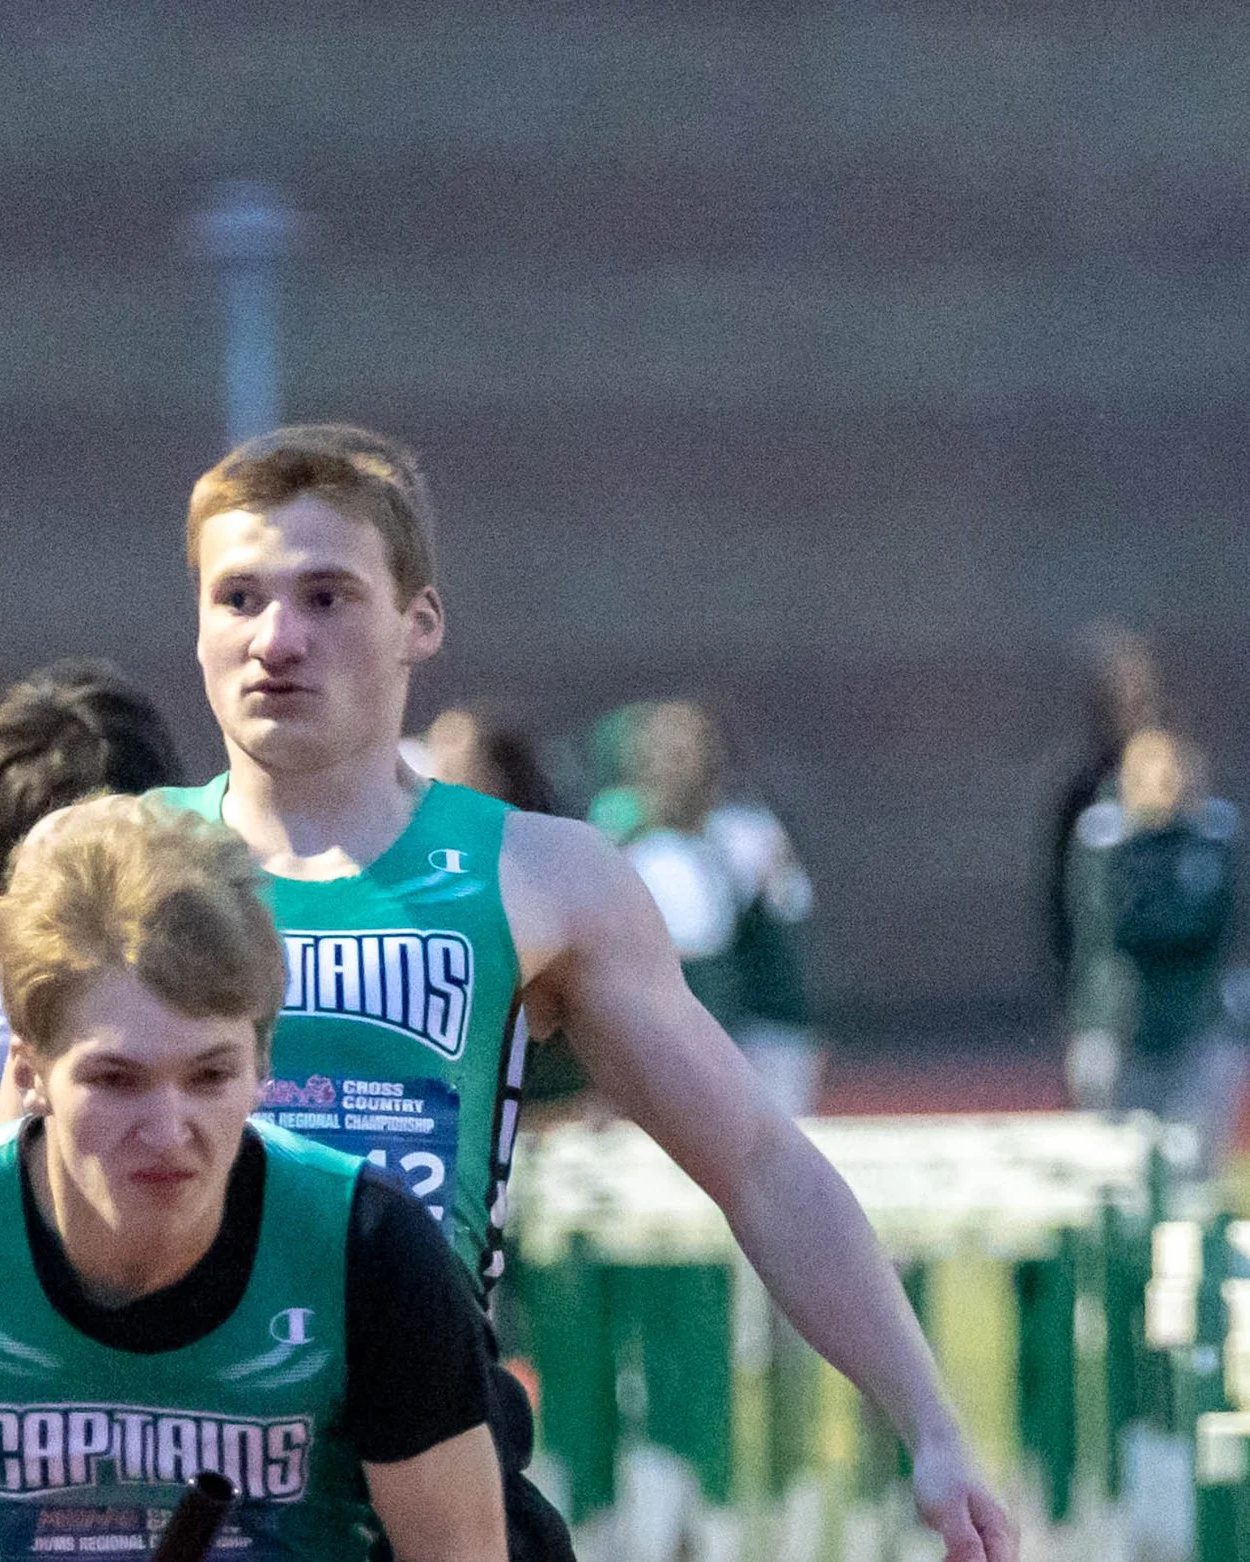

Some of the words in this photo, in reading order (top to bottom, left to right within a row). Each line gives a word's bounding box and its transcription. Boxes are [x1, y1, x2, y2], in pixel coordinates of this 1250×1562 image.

[283, 932, 468, 1053] TAINS
[342, 1080, 405, 1097] CROSS
[342, 1096, 425, 1113] COUNTRY
[278, 1112, 341, 1130] REGIONAL
[344, 1113, 435, 1134] CHAMPIONSHIP
[78, 1533, 147, 1551] REGIONAL
